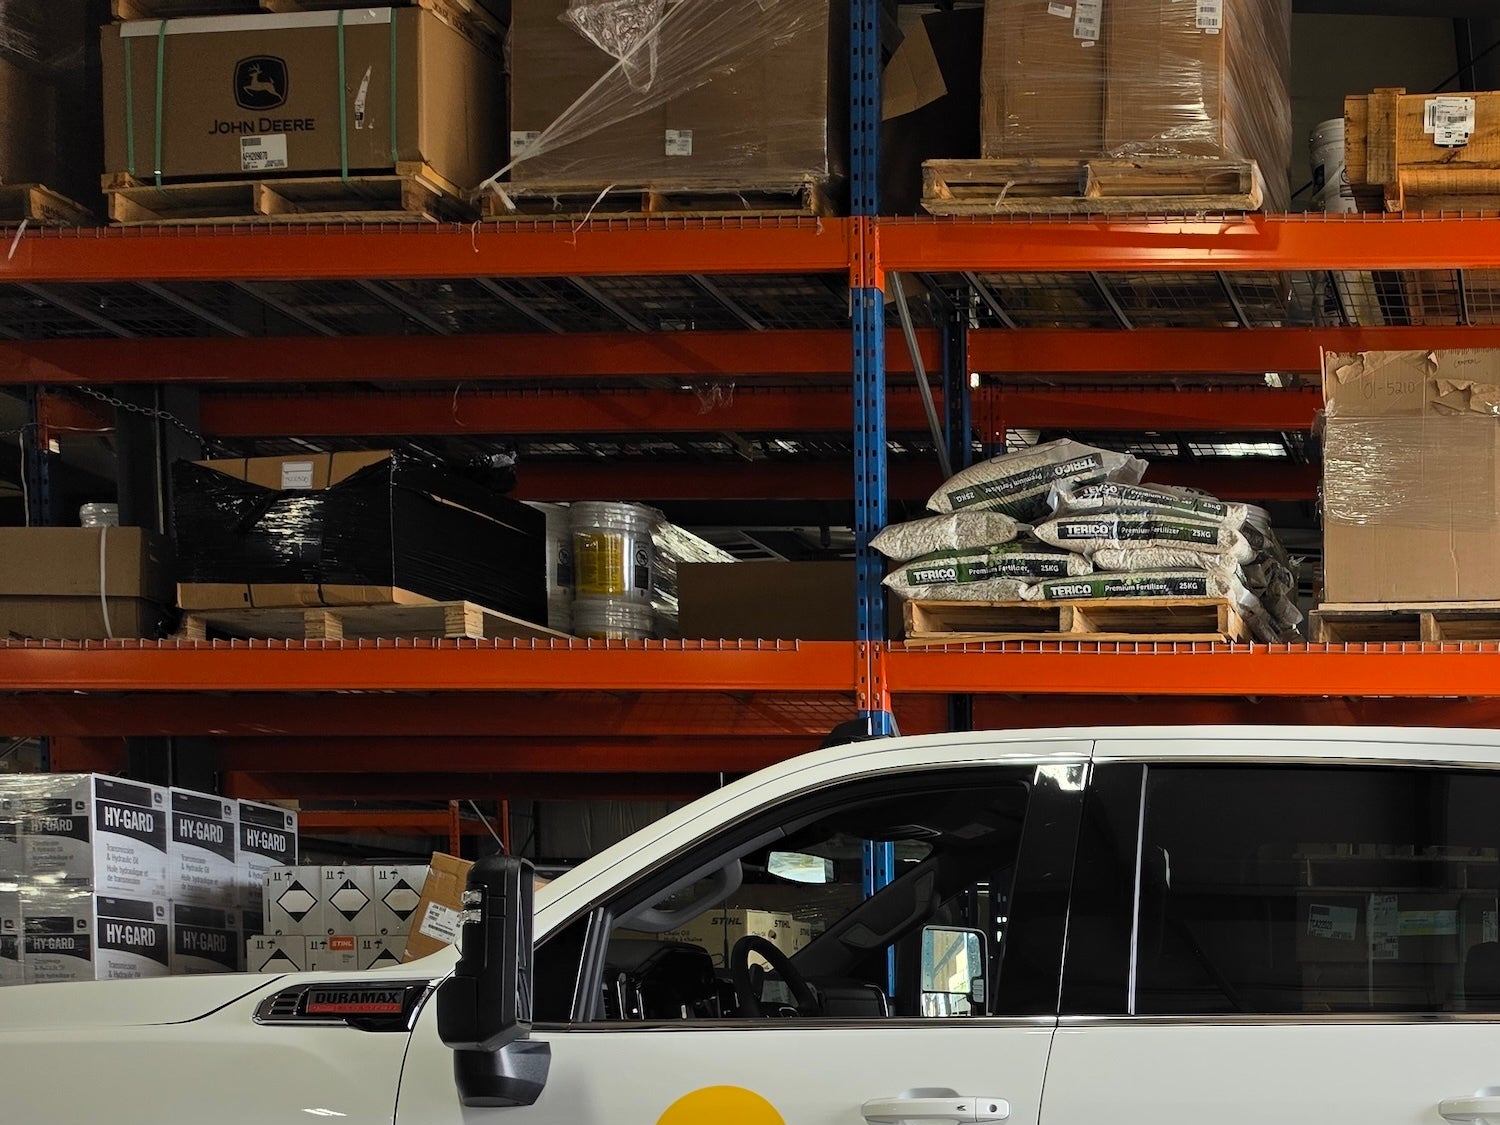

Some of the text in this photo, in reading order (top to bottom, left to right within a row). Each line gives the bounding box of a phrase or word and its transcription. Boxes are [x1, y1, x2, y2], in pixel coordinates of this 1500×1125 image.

[208, 118, 315, 135] JOHN DEERE
[1363, 381, 1416, 400] 01-5210
[1054, 456, 1097, 476] TERICO
[1013, 472, 1043, 489] Premium
[955, 491, 975, 503] 25KG
[1130, 489, 1161, 501] Premium
[1066, 524, 1212, 538] TERICO Premium Fertilizer 25KG
[913, 567, 956, 581] TERICO
[969, 566, 997, 576] Premium
[1040, 564, 1060, 573] 25KG
[1050, 583, 1092, 596] TERICO
[1104, 584, 1134, 593] Premium
[1178, 582, 1199, 590] 25KG
[31, 818, 73, 832] HY-GARD
[104, 806, 154, 833] HY-GARD
[179, 818, 224, 844] HY-GARD
[246, 828, 286, 853] HY-GARD
[711, 917, 743, 926] STIHL
[774, 919, 791, 929] STIHL
[33, 937, 75, 950] HY-GARD
[106, 923, 156, 947] HY-GARD
[183, 930, 227, 953] HY-GARD
[315, 992, 399, 1004] DURAMAX
